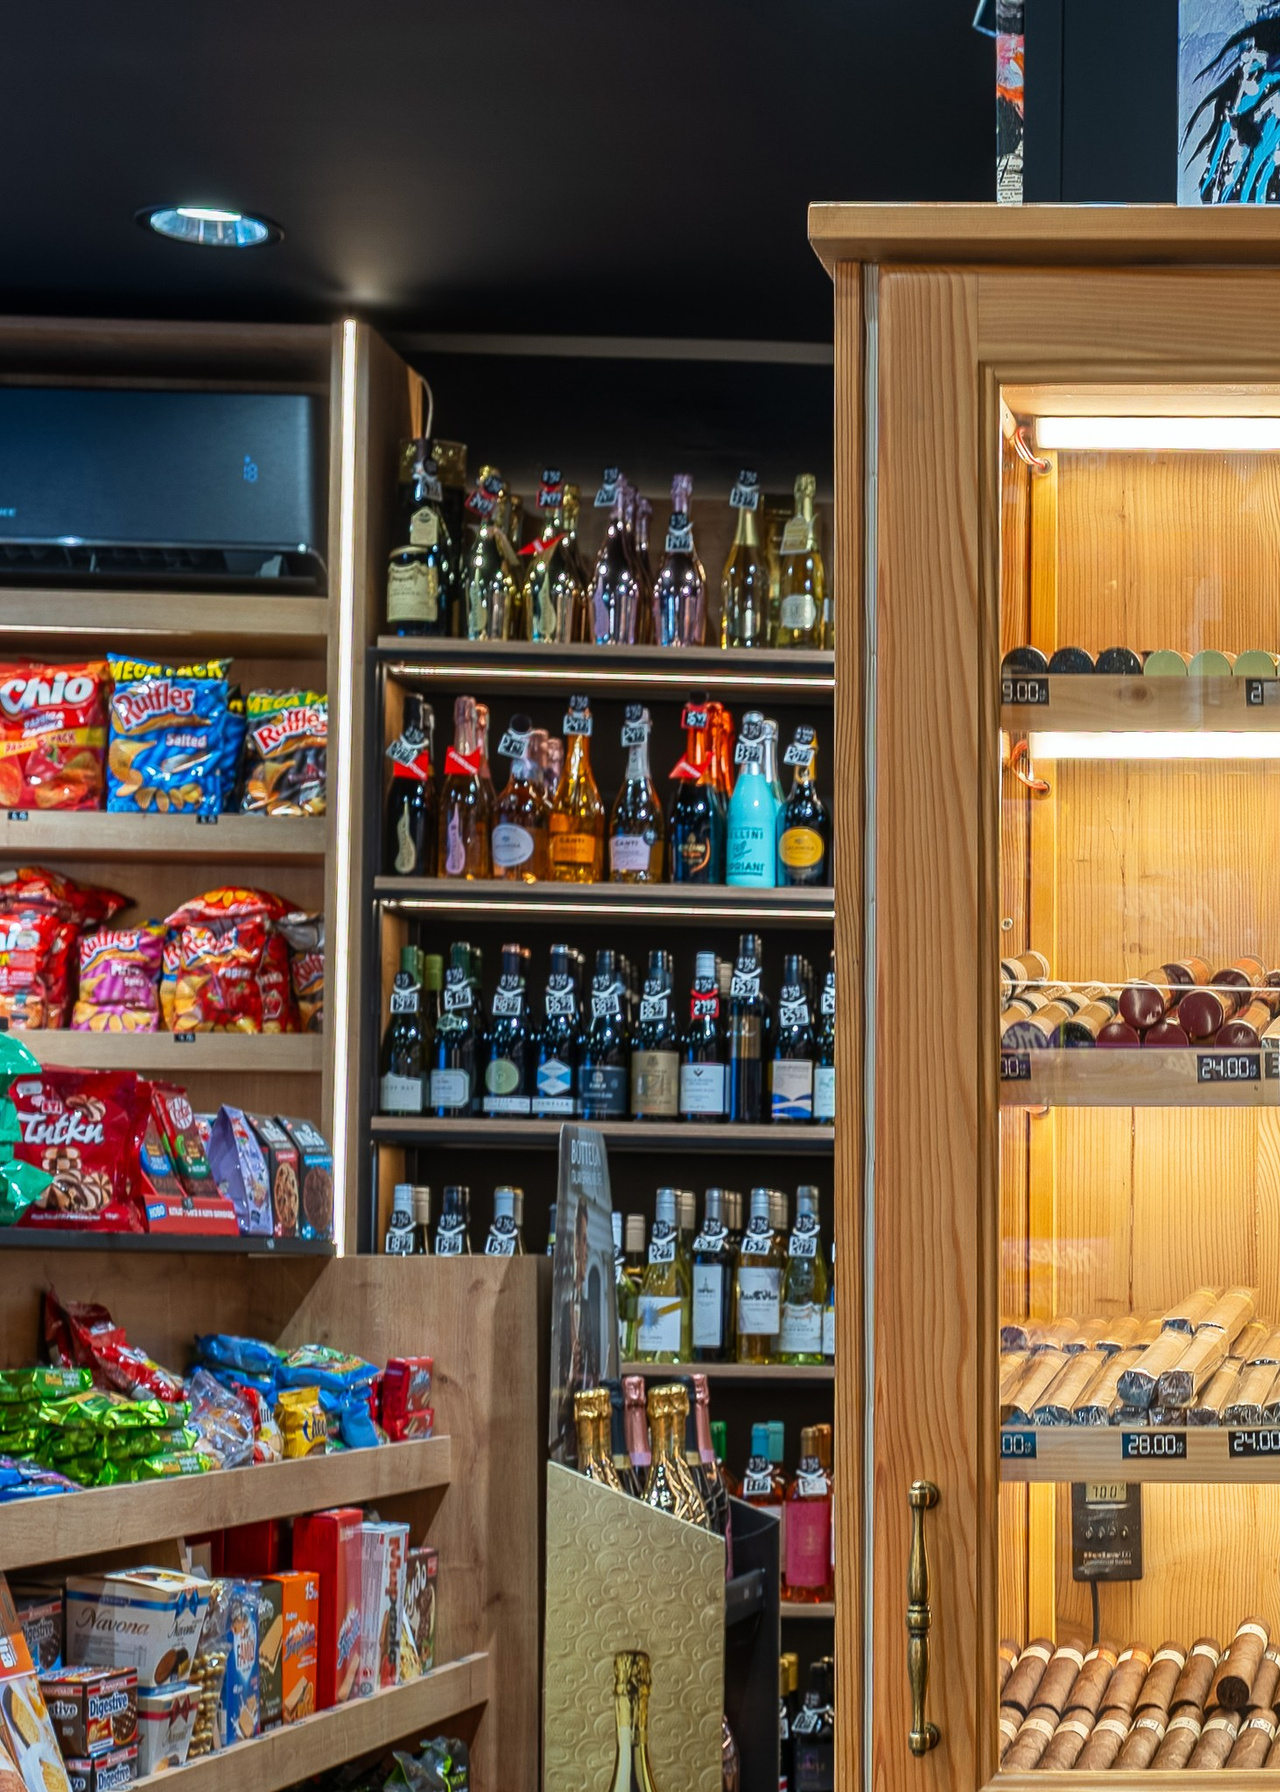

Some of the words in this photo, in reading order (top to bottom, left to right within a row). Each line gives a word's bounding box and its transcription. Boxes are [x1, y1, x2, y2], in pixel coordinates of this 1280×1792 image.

[1, 672, 94, 715] Chio
[115, 686, 195, 732] Ruffles
[166, 734, 207, 748] Salted
[1202, 1057, 1249, 1078] 24.00
[1128, 1435, 1175, 1455] 28.00
[76, 1607, 150, 1637] Navona
[89, 1691, 129, 1721] Digestive
[96, 1763, 131, 1792] Digestive
